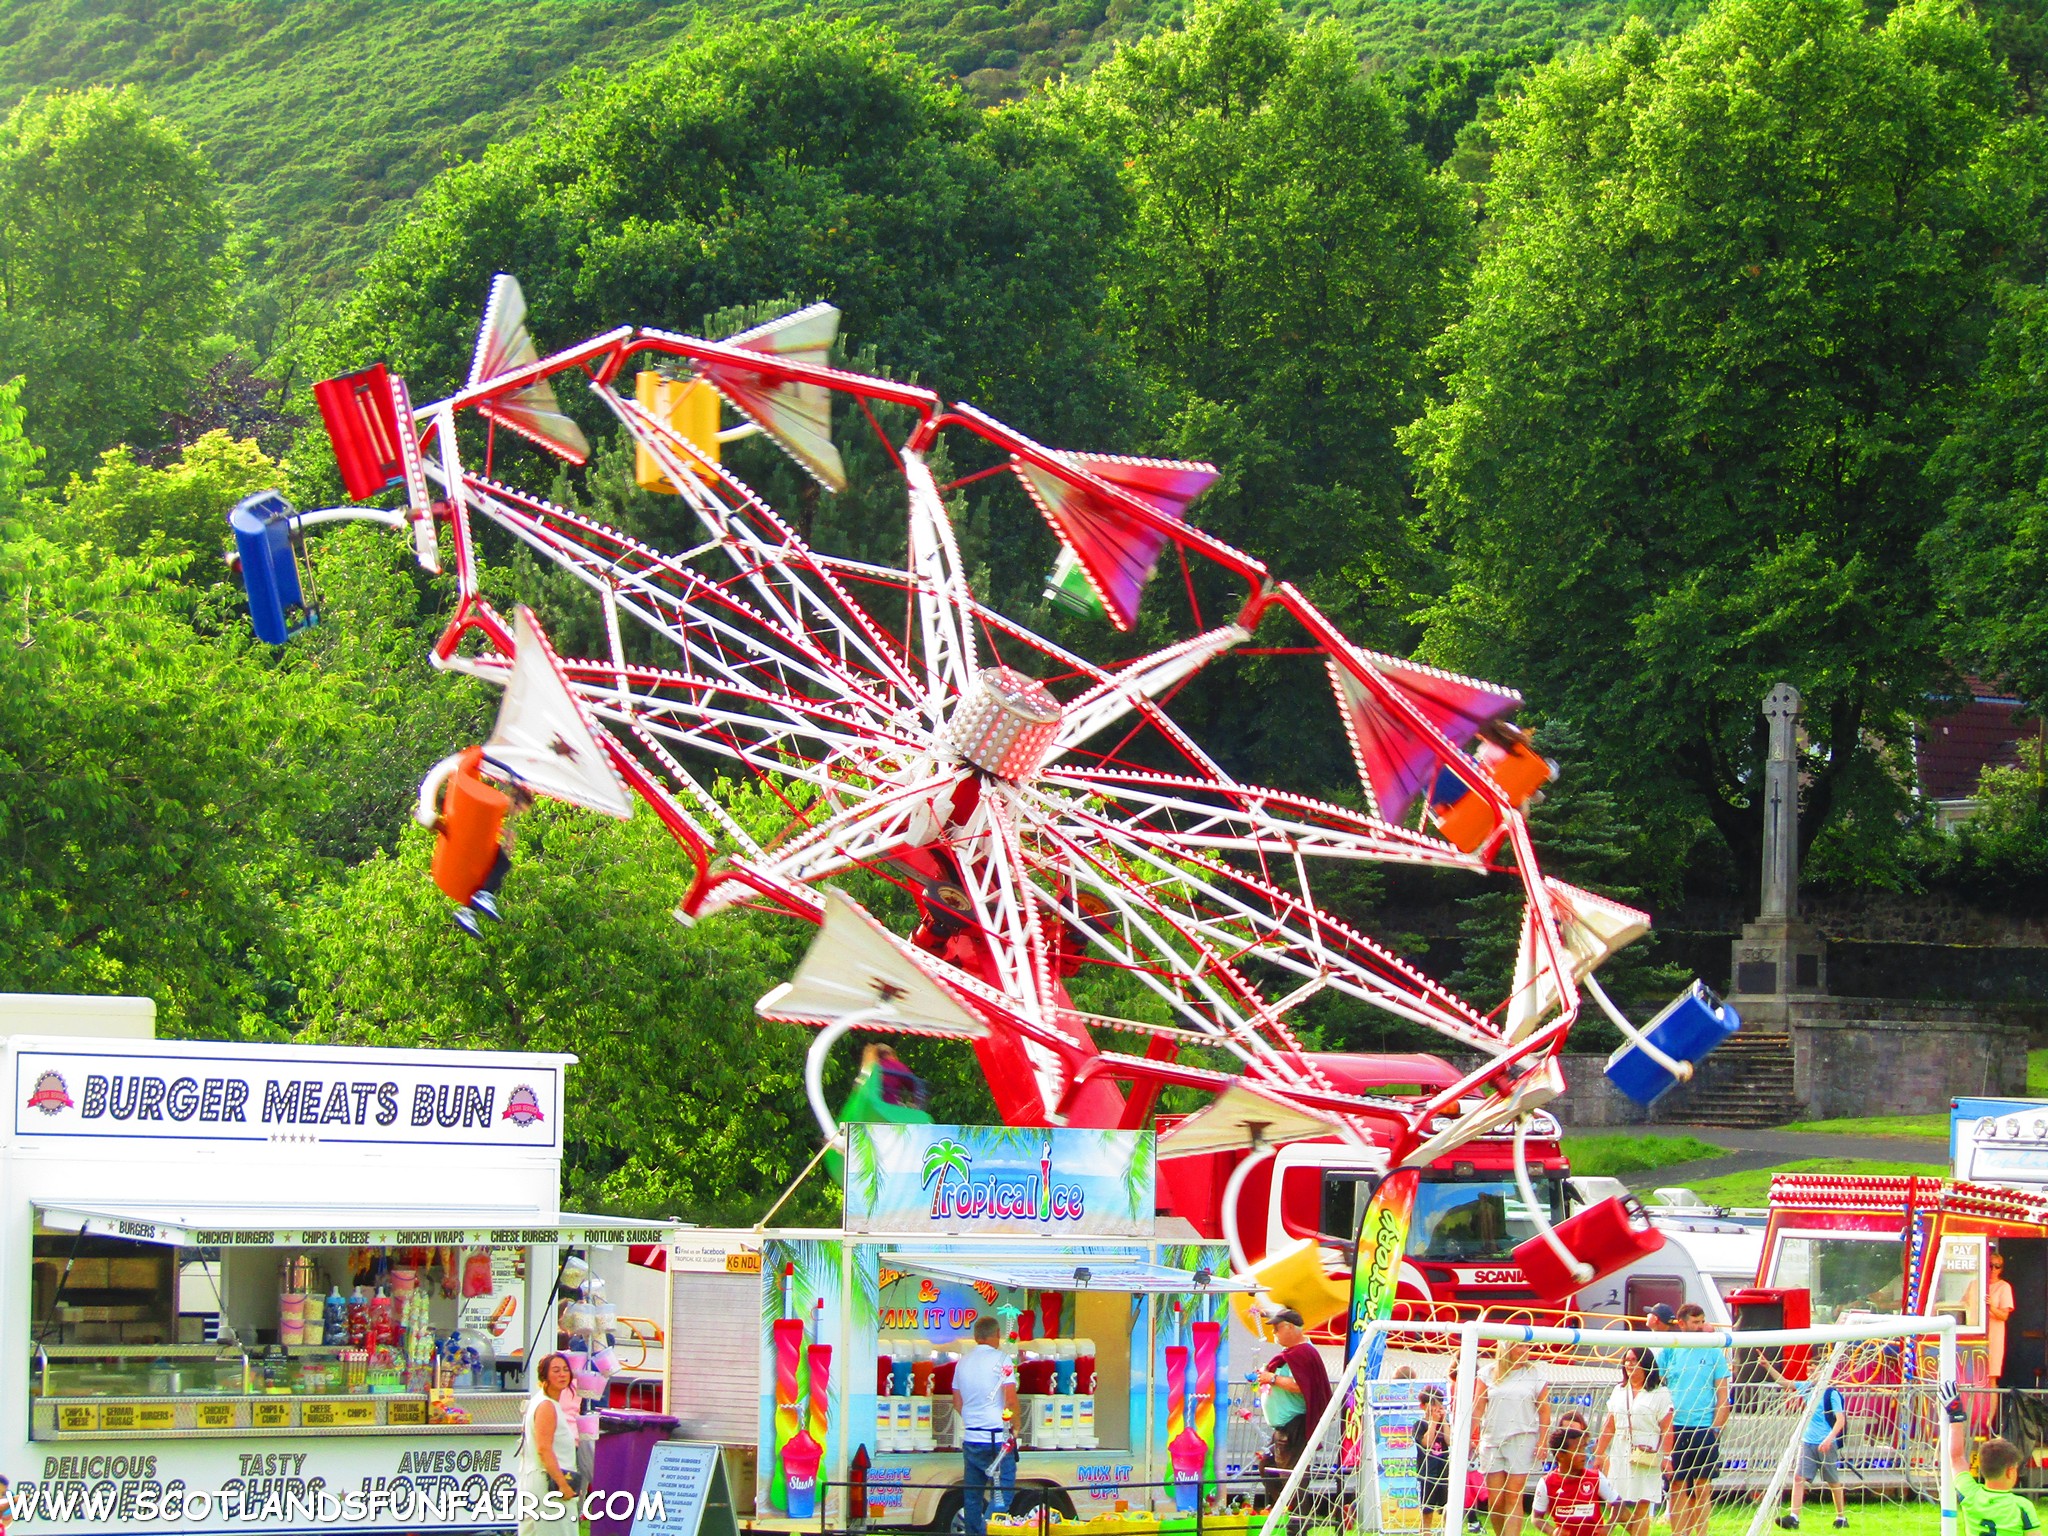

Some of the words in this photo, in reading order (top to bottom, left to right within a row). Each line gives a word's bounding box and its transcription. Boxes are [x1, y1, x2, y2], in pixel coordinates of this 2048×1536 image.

[81, 1075, 249, 1122] BURGER
[261, 1079, 399, 1126] MEATS
[410, 1084, 495, 1128] BUN
[922, 1137, 1037, 1220] Tropical
[1039, 1141, 1084, 1220] Ice
[119, 1220, 155, 1239] BURGERS
[196, 1232, 233, 1244] CHICKEN
[235, 1231, 275, 1244] BURGERS
[302, 1231, 327, 1243] CHIPS
[329, 1231, 336, 1244] &
[339, 1231, 370, 1244] CHEESE
[396, 1231, 431, 1244] CHICKEN
[434, 1231, 464, 1244] WRAPS
[490, 1230, 521, 1243] CHEESE
[522, 1230, 559, 1243] BURGERS
[584, 1230, 624, 1243] FOOTLONG
[625, 1230, 662, 1243] SAUSAGE
[702, 1247, 726, 1255] facebook
[1952, 1245, 1973, 1256] PAY
[727, 1257, 738, 1268] K6
[741, 1257, 758, 1269] NDL
[1946, 1259, 1976, 1270] HERE
[918, 1279, 941, 1303] &
[879, 1308, 919, 1329] MIX
[923, 1308, 946, 1329] IT
[948, 1308, 978, 1330] UP
[65, 1407, 83, 1417] CHIPS
[85, 1406, 91, 1417] &
[106, 1407, 134, 1416] GERMAN
[203, 1406, 230, 1415] CHICKEN
[260, 1405, 278, 1414] CHIPS
[279, 1405, 284, 1414] &
[309, 1404, 332, 1413] CHEESE
[347, 1408, 367, 1418] CHIPS
[393, 1403, 419, 1412] FOOTLONG
[67, 1417, 89, 1426] CHEESE
[106, 1416, 134, 1425] SAUSAGE
[140, 1411, 169, 1420] BURGERS
[205, 1415, 228, 1424] WRAPS
[262, 1414, 282, 1423] CURRY
[307, 1413, 334, 1423] BURGERS
[393, 1412, 420, 1422] SAUSAGE
[44, 1455, 157, 1480] DELICIOUS
[239, 1453, 307, 1476] TASTY
[397, 1450, 502, 1474] AWESOME
[867, 1467, 912, 1481] REATE
[1077, 1464, 1111, 1482] MIX
[1114, 1464, 1133, 1482] IT
[1176, 1470, 1199, 1483] Slush
[788, 1475, 815, 1490] Slush
[1089, 1482, 1119, 1499] UP!
